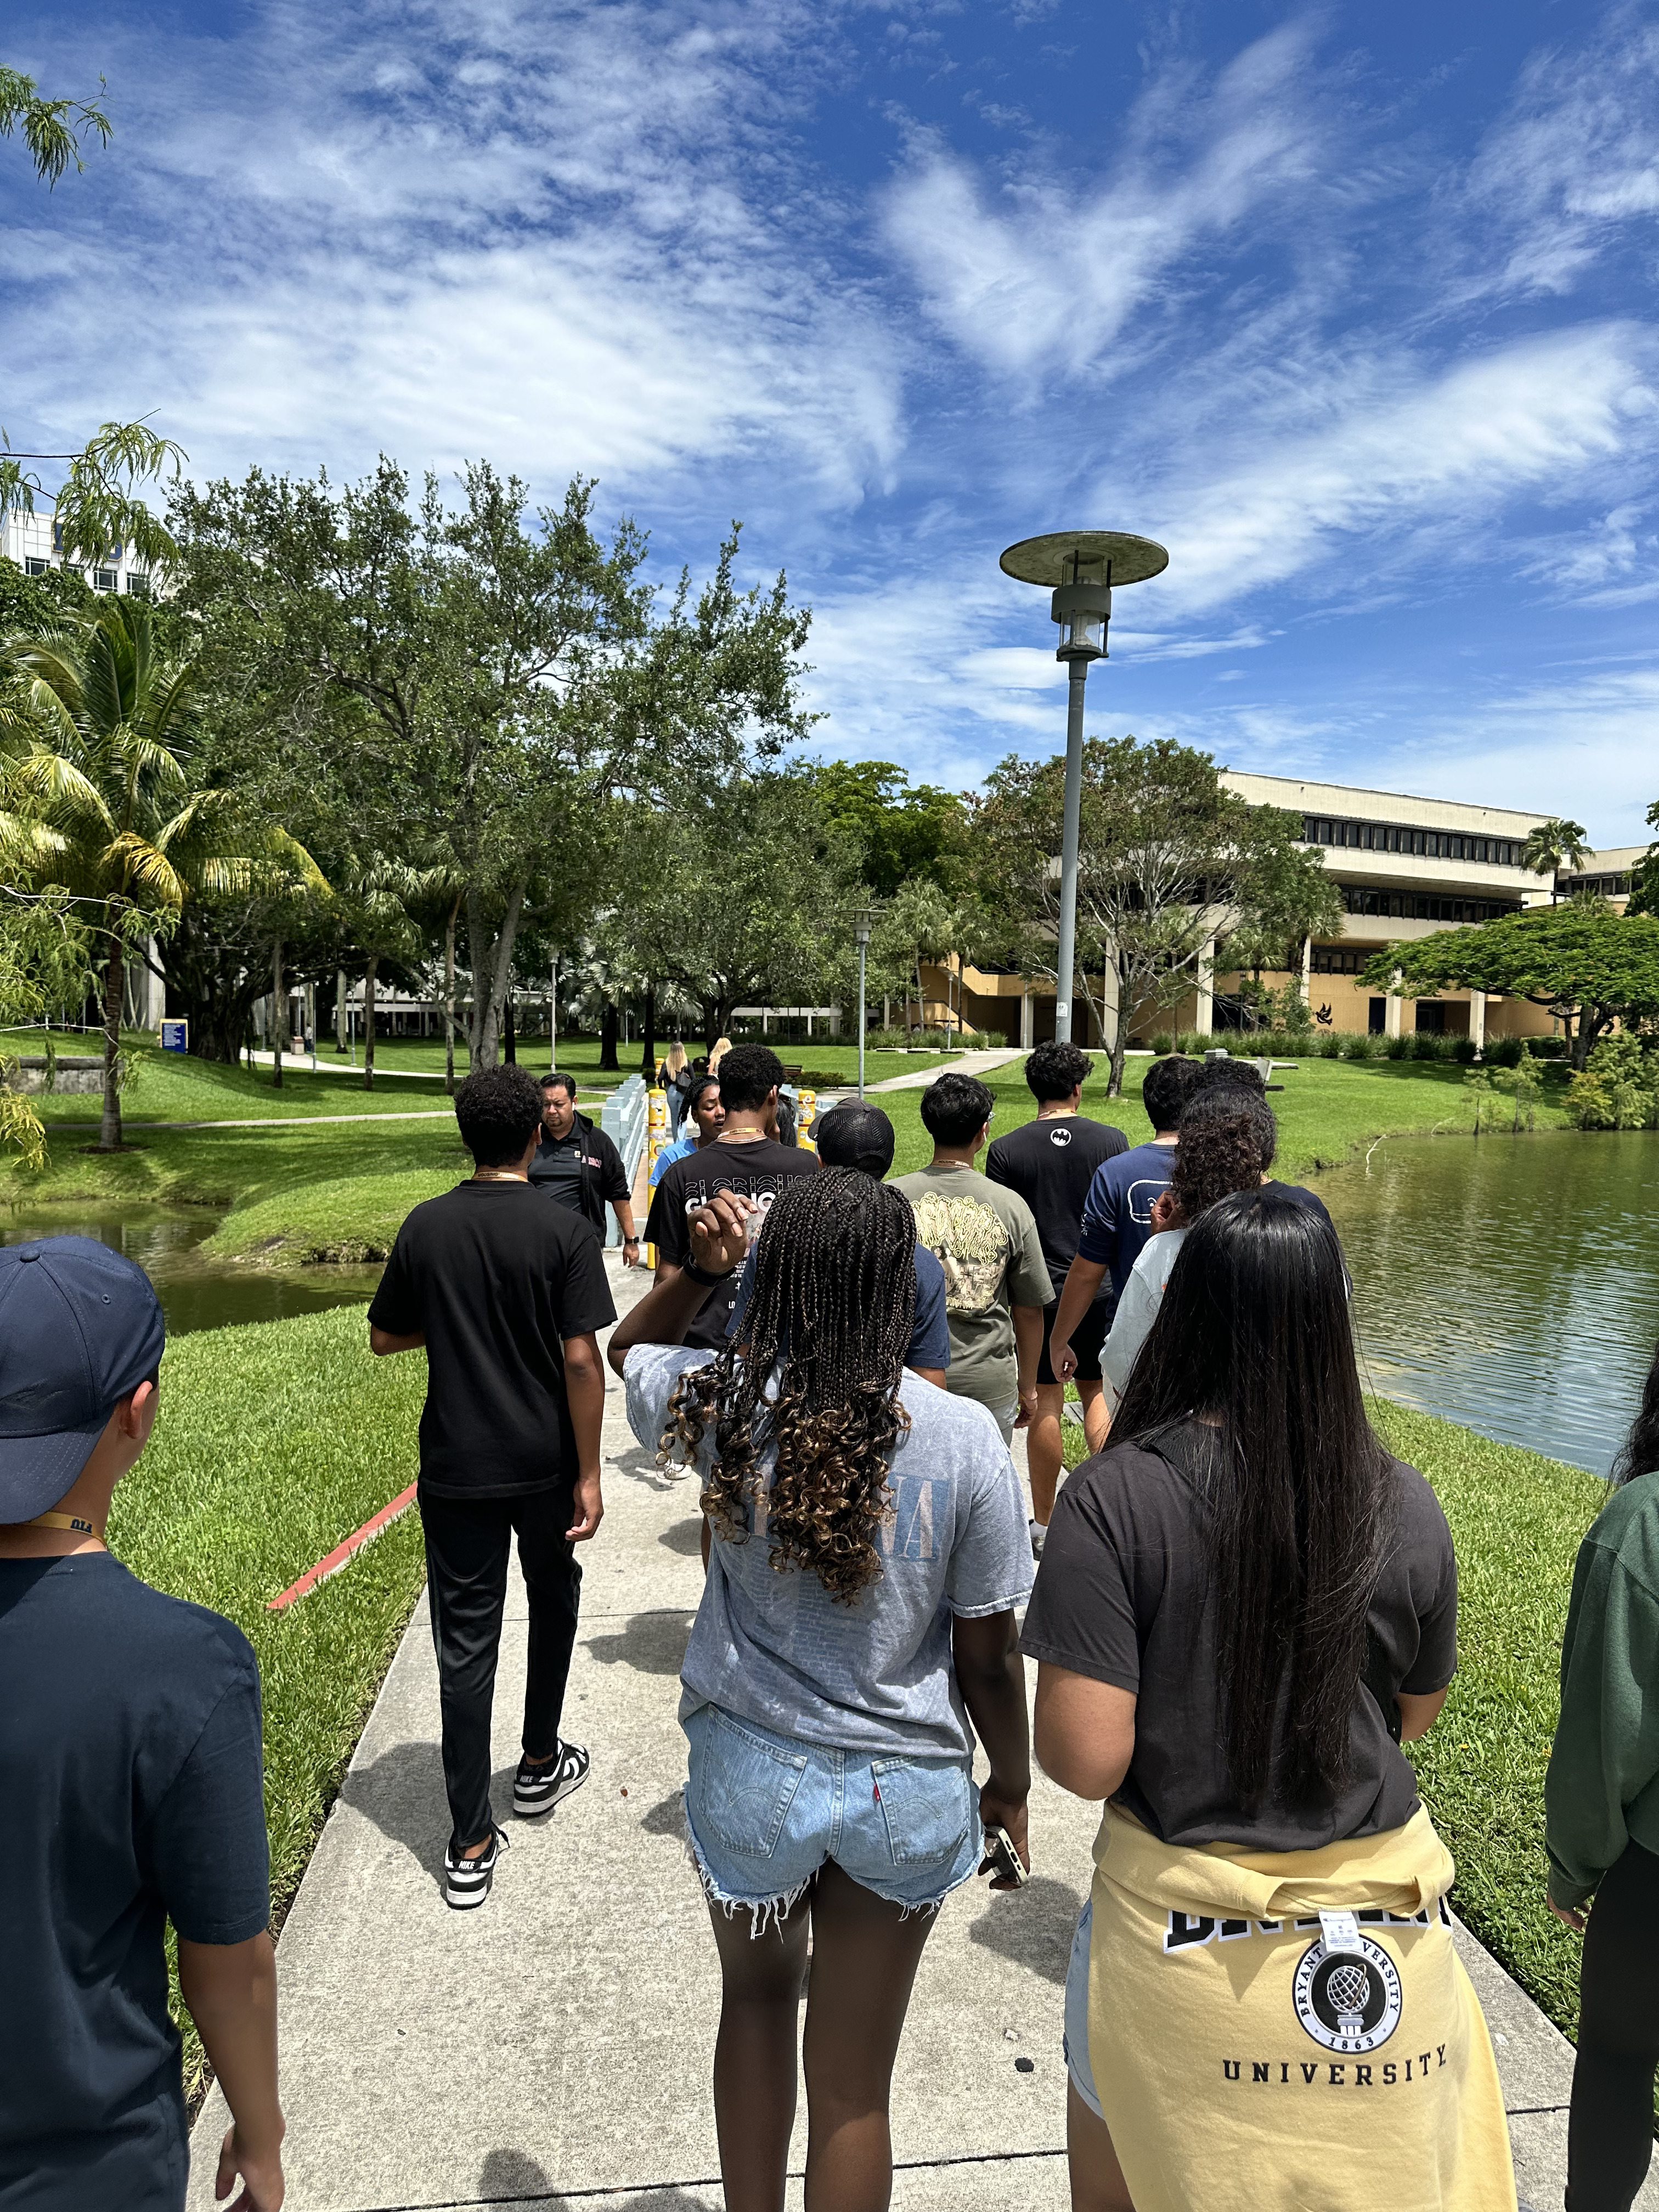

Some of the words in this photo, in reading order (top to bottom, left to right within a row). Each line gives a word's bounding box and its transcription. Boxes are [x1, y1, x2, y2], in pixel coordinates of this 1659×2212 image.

[71, 1519, 92, 1533] FIU
[459, 1860, 475, 1869] NIKE
[1297, 1947, 1323, 2017] BRYANT
[1328, 2036, 1374, 2050] 1863
[1222, 2043, 1447, 2086] UNIVERSITY
